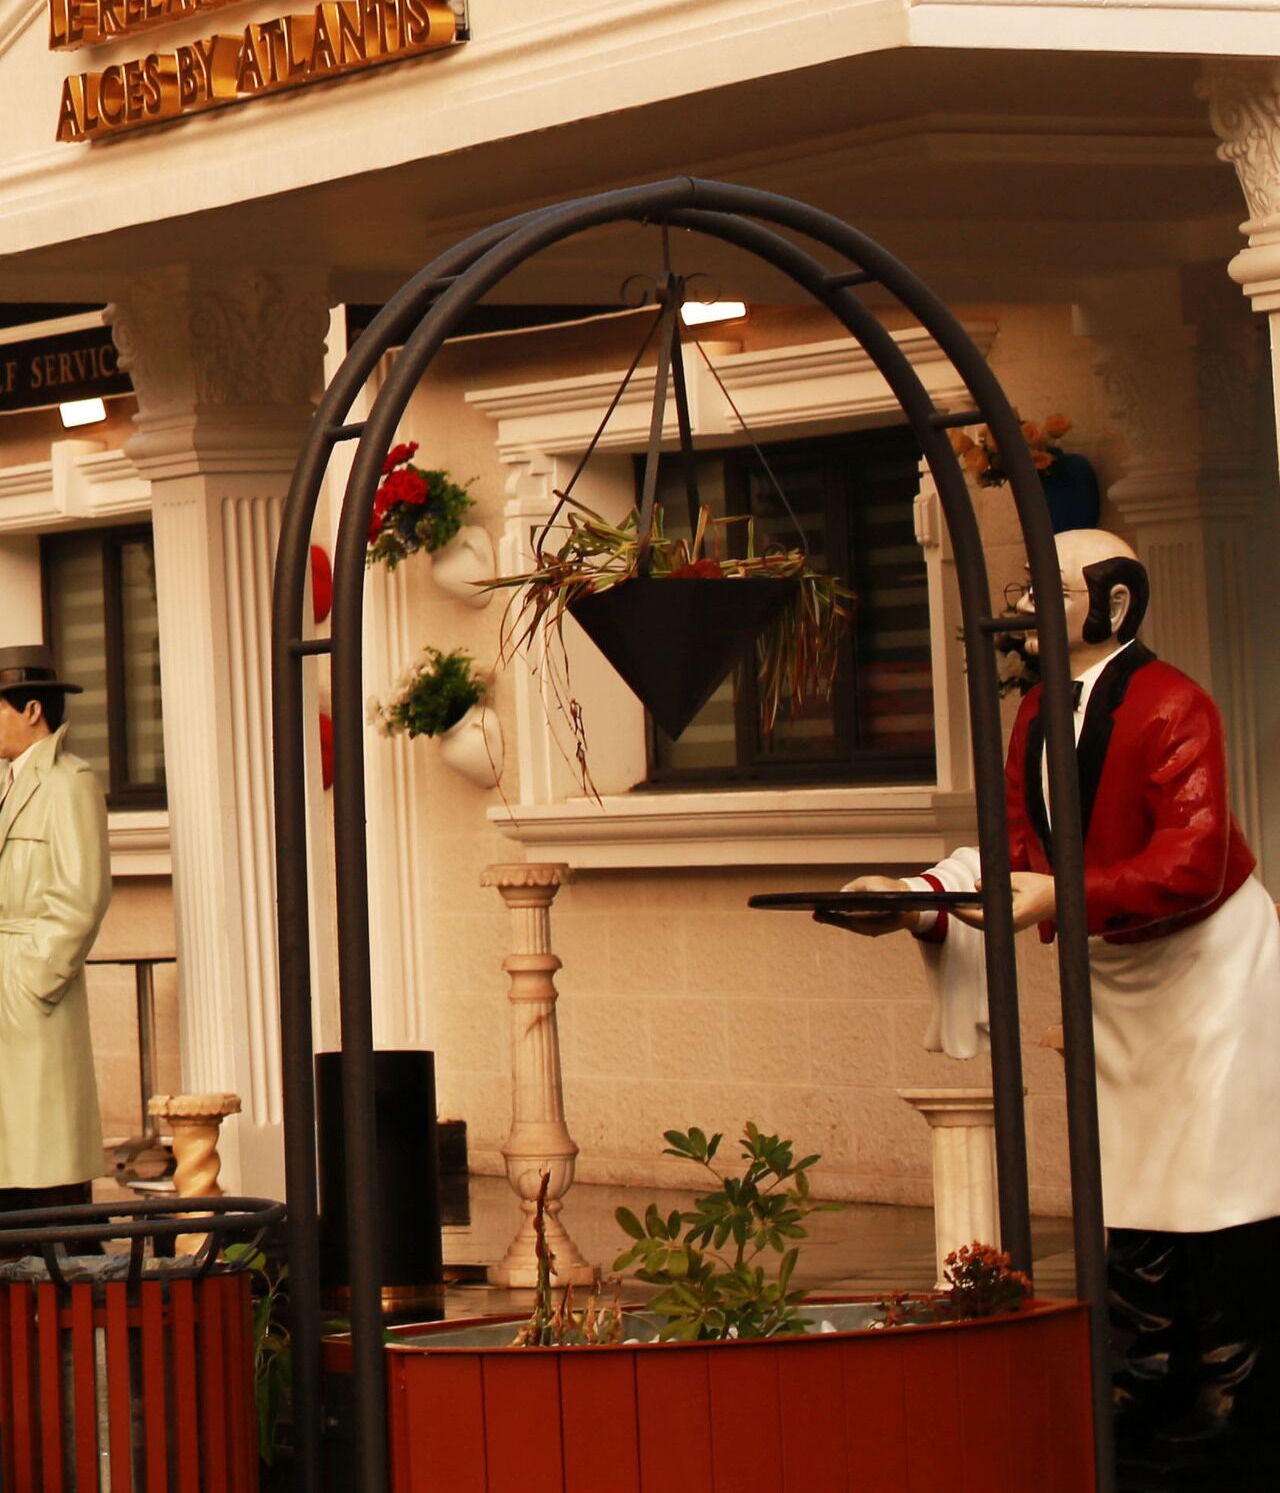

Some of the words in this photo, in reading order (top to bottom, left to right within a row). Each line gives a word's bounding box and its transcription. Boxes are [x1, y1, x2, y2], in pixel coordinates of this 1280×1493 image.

[55, 53, 162, 142] ALCES
[177, 35, 217, 108] BY
[31, 344, 120, 390] SERVIC
